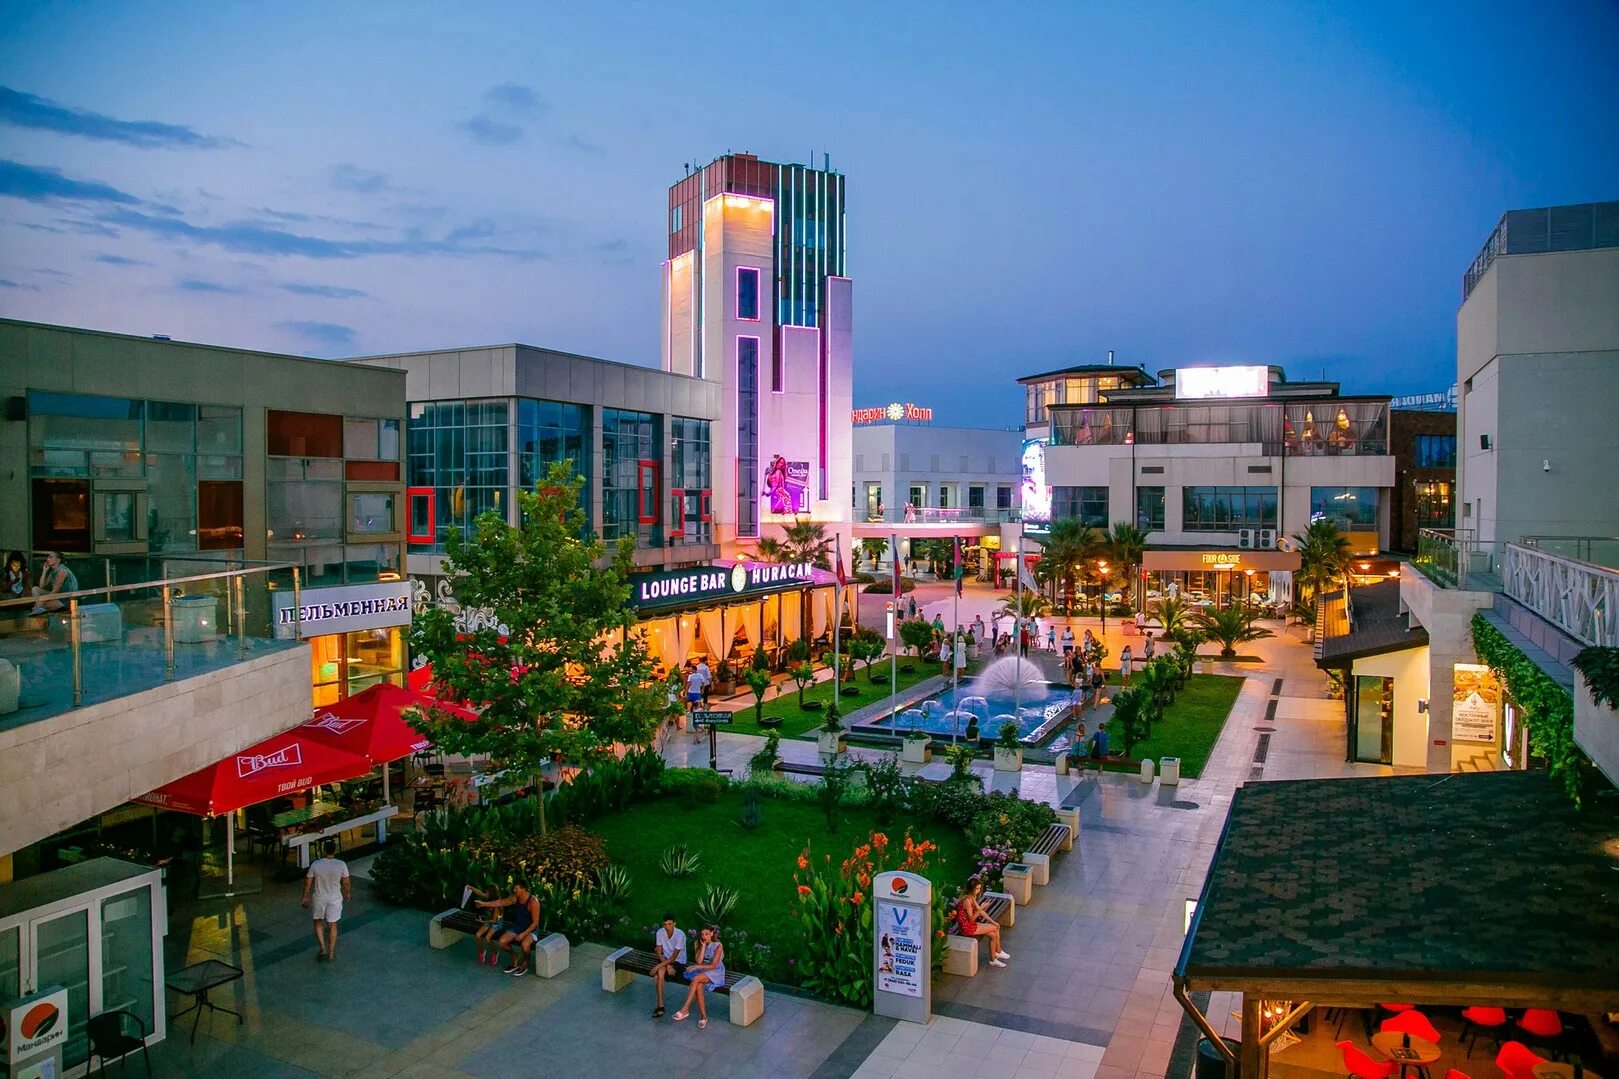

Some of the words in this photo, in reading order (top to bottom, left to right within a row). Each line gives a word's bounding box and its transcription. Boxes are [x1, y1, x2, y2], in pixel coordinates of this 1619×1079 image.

[850, 407, 886, 424] ндарин
[1202, 554, 1217, 564] FOUR
[1228, 554, 1241, 564] SIDE
[641, 575, 697, 600] LOUNGE
[700, 573, 725, 591] BAR
[752, 563, 812, 584] HURACAN
[280, 597, 408, 624] ПЕЛЬМЕННАЯ
[241, 750, 288, 771] Bud
[277, 779, 297, 793] ТВОЙ
[297, 776, 313, 788] BUD
[892, 907, 908, 925] V
[895, 958, 915, 966] FEDUK
[16, 1030, 63, 1054] Мандарин
